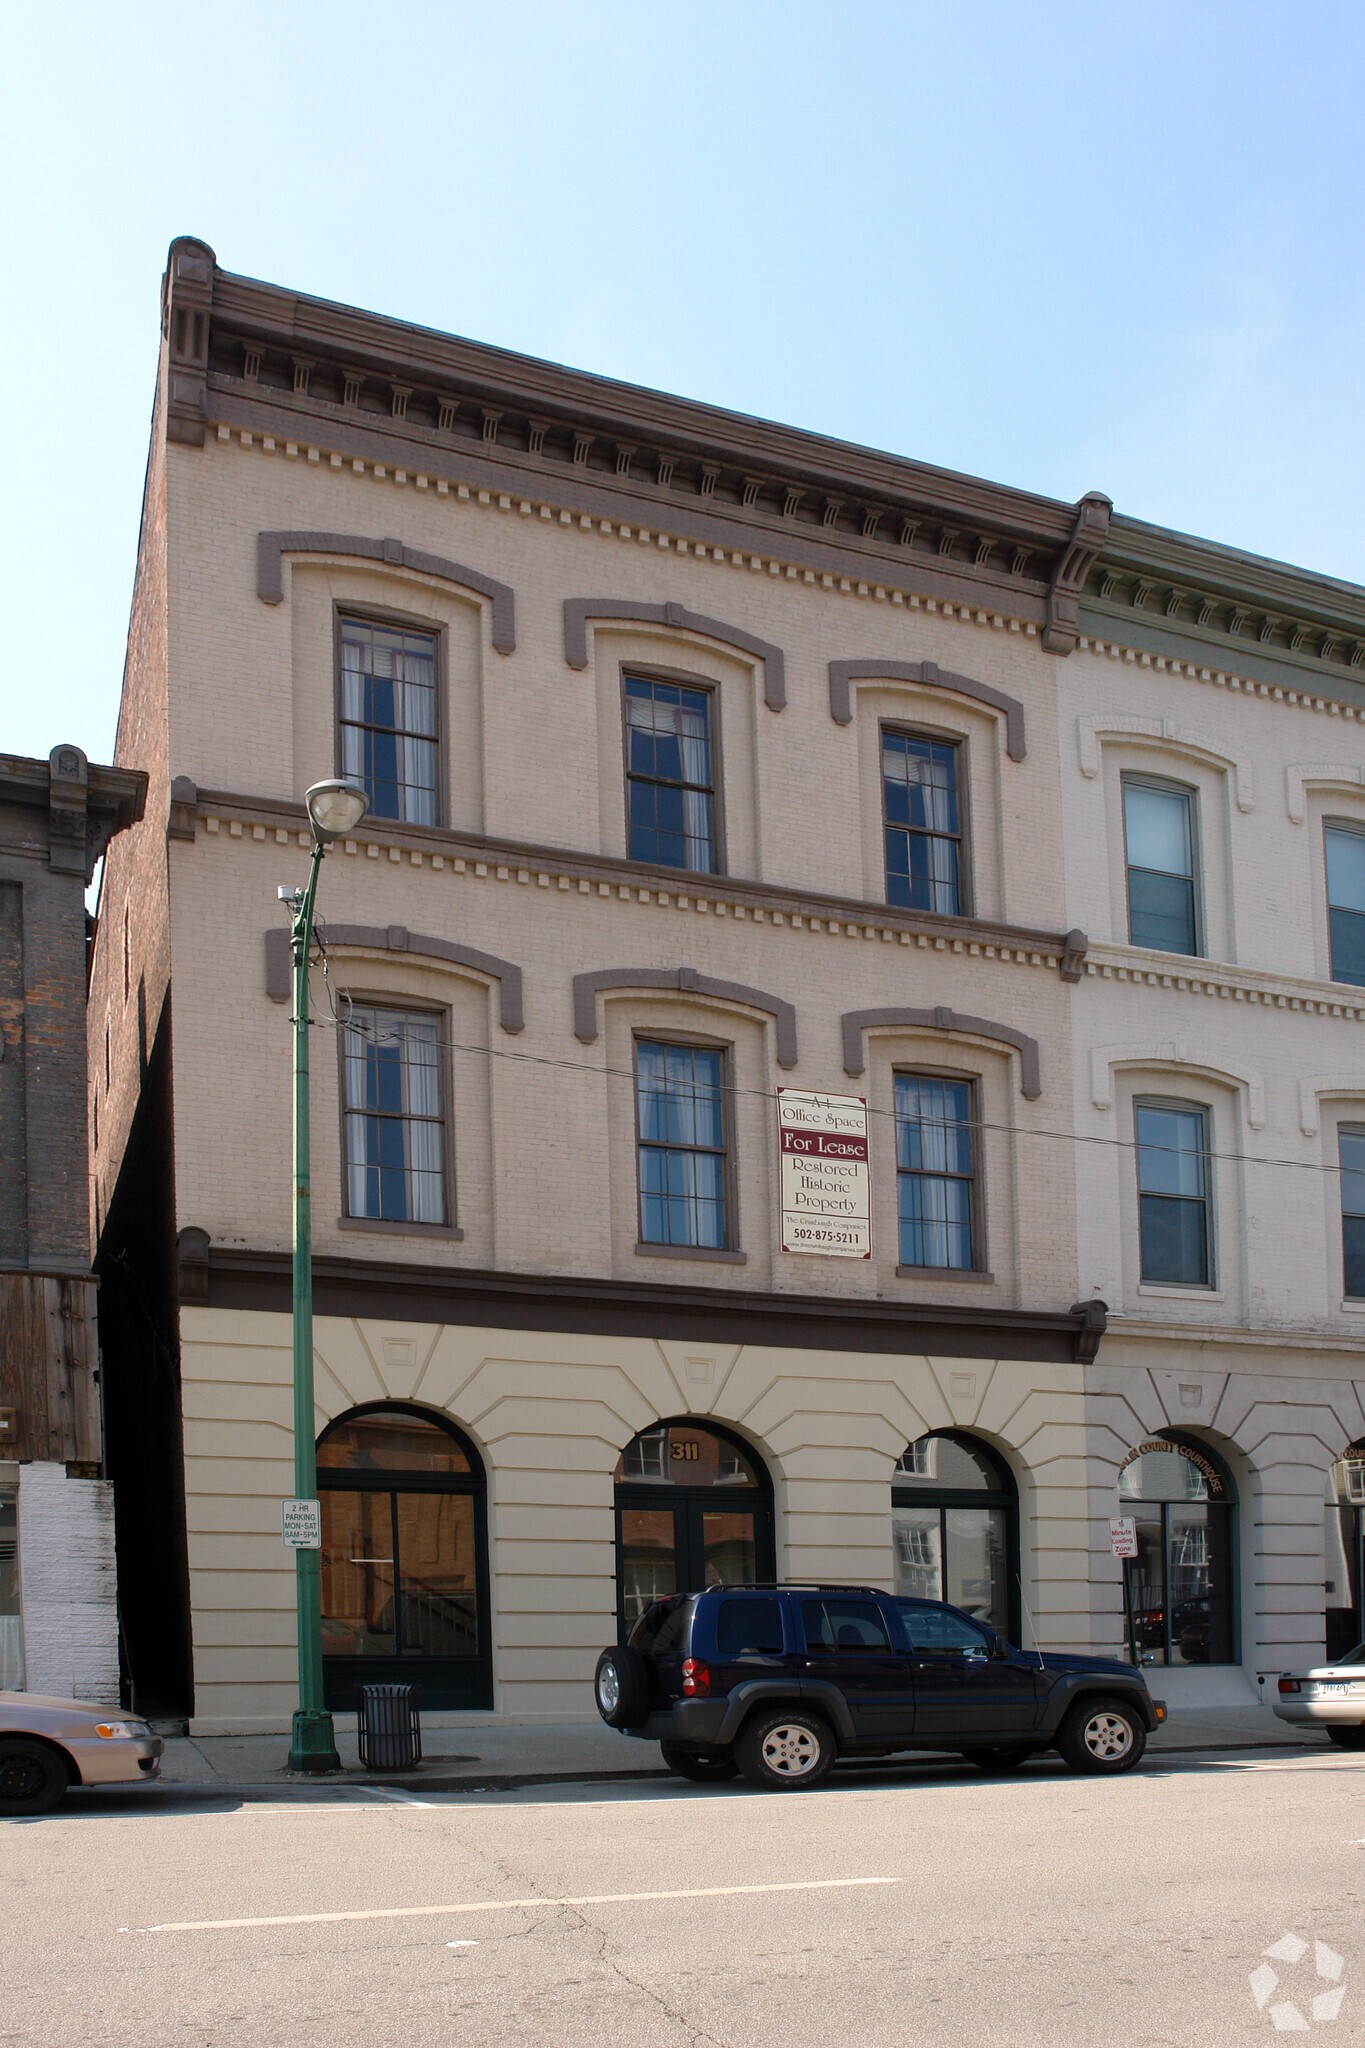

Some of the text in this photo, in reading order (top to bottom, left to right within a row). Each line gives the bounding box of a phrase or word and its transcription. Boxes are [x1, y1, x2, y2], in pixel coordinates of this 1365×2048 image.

[782, 1107, 864, 1129] Office Space
[784, 1132, 865, 1157] For Lease
[792, 1157, 858, 1177] Restored
[801, 1175, 850, 1193] Historic
[795, 1192, 857, 1214] Property
[786, 1216, 798, 1224] The
[671, 1441, 699, 1461] 311
[1180, 1445, 1223, 1493] COURTHOUSE
